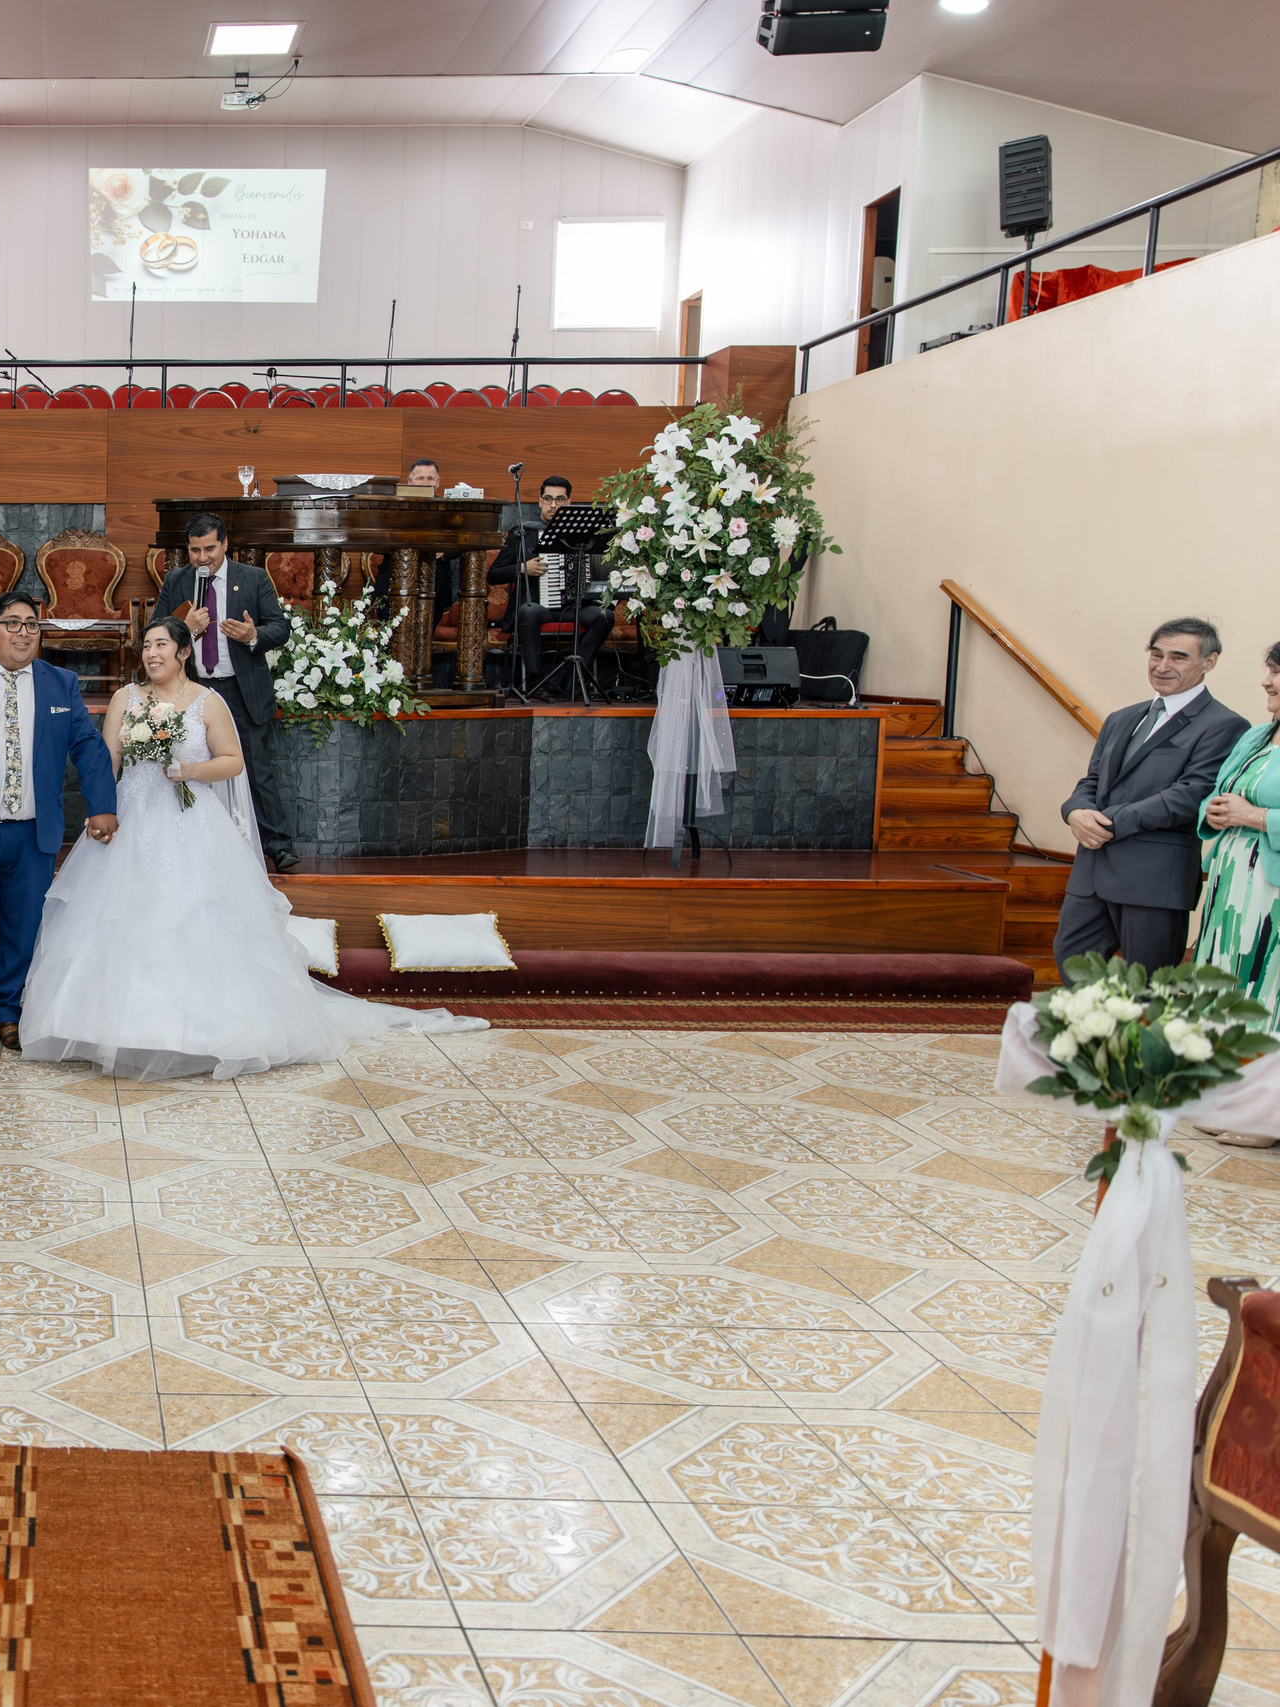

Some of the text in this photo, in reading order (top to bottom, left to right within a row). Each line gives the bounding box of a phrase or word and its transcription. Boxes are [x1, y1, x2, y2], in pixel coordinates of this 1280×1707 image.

[234, 183, 306, 204] Bienvenidos
[220, 212, 259, 220] BODAS DE
[232, 228, 287, 240] YOHANA
[259, 243, 266, 251] Y
[242, 253, 286, 264] EDGAR
